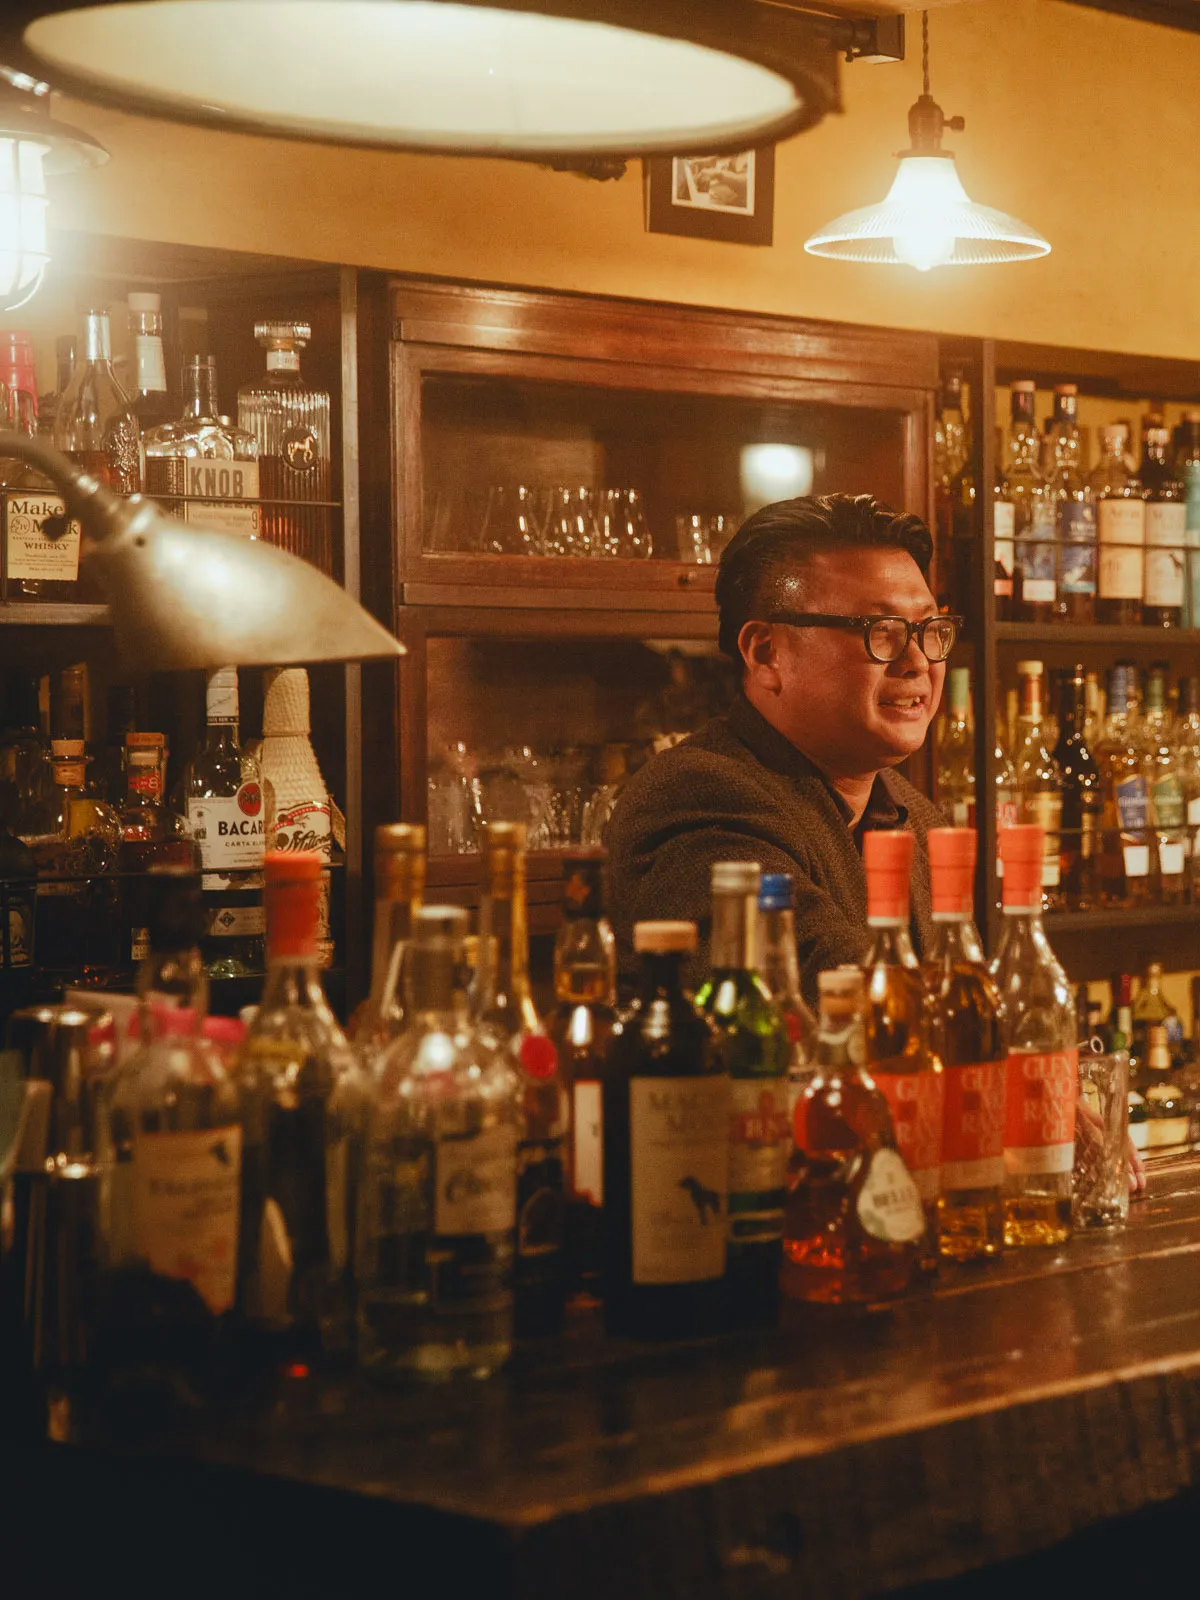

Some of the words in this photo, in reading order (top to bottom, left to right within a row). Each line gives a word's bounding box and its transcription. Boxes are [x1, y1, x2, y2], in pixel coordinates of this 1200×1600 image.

[191, 467, 243, 498] KNOB
[9, 501, 64, 516] Make
[24, 542, 69, 551] WHISKY
[218, 820, 266, 836] BACAR
[1022, 1056, 1071, 1079] GLEN
